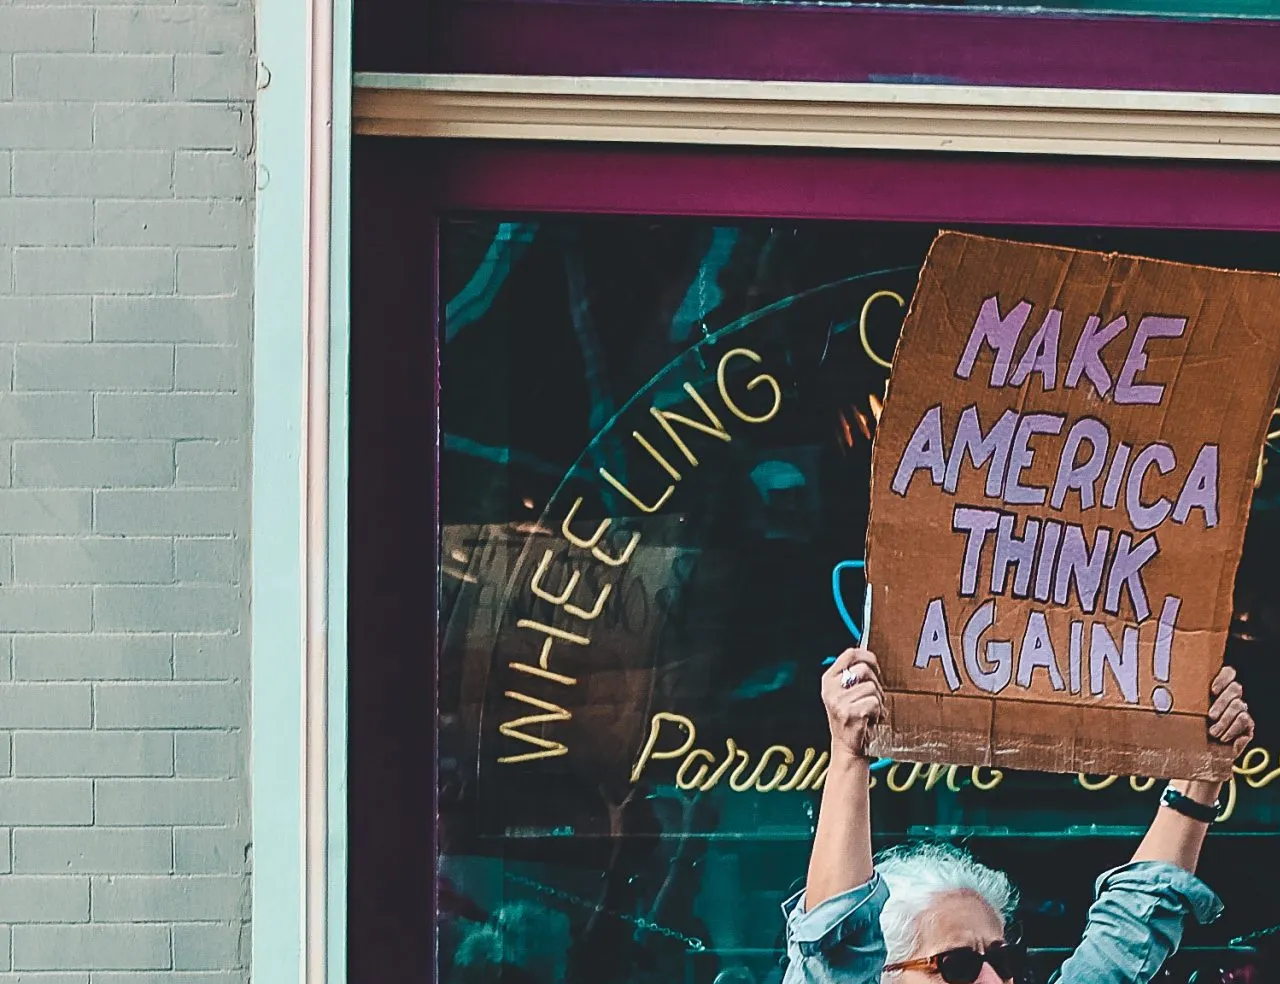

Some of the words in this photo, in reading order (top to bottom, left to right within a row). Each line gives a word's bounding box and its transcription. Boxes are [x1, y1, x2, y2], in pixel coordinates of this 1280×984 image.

[955, 295, 1187, 405] MAKE
[890, 404, 1221, 532] AMERICA
[497, 348, 782, 764] WHEELING
[951, 507, 1161, 623] THINK
[913, 595, 1182, 715] AGAIN!
